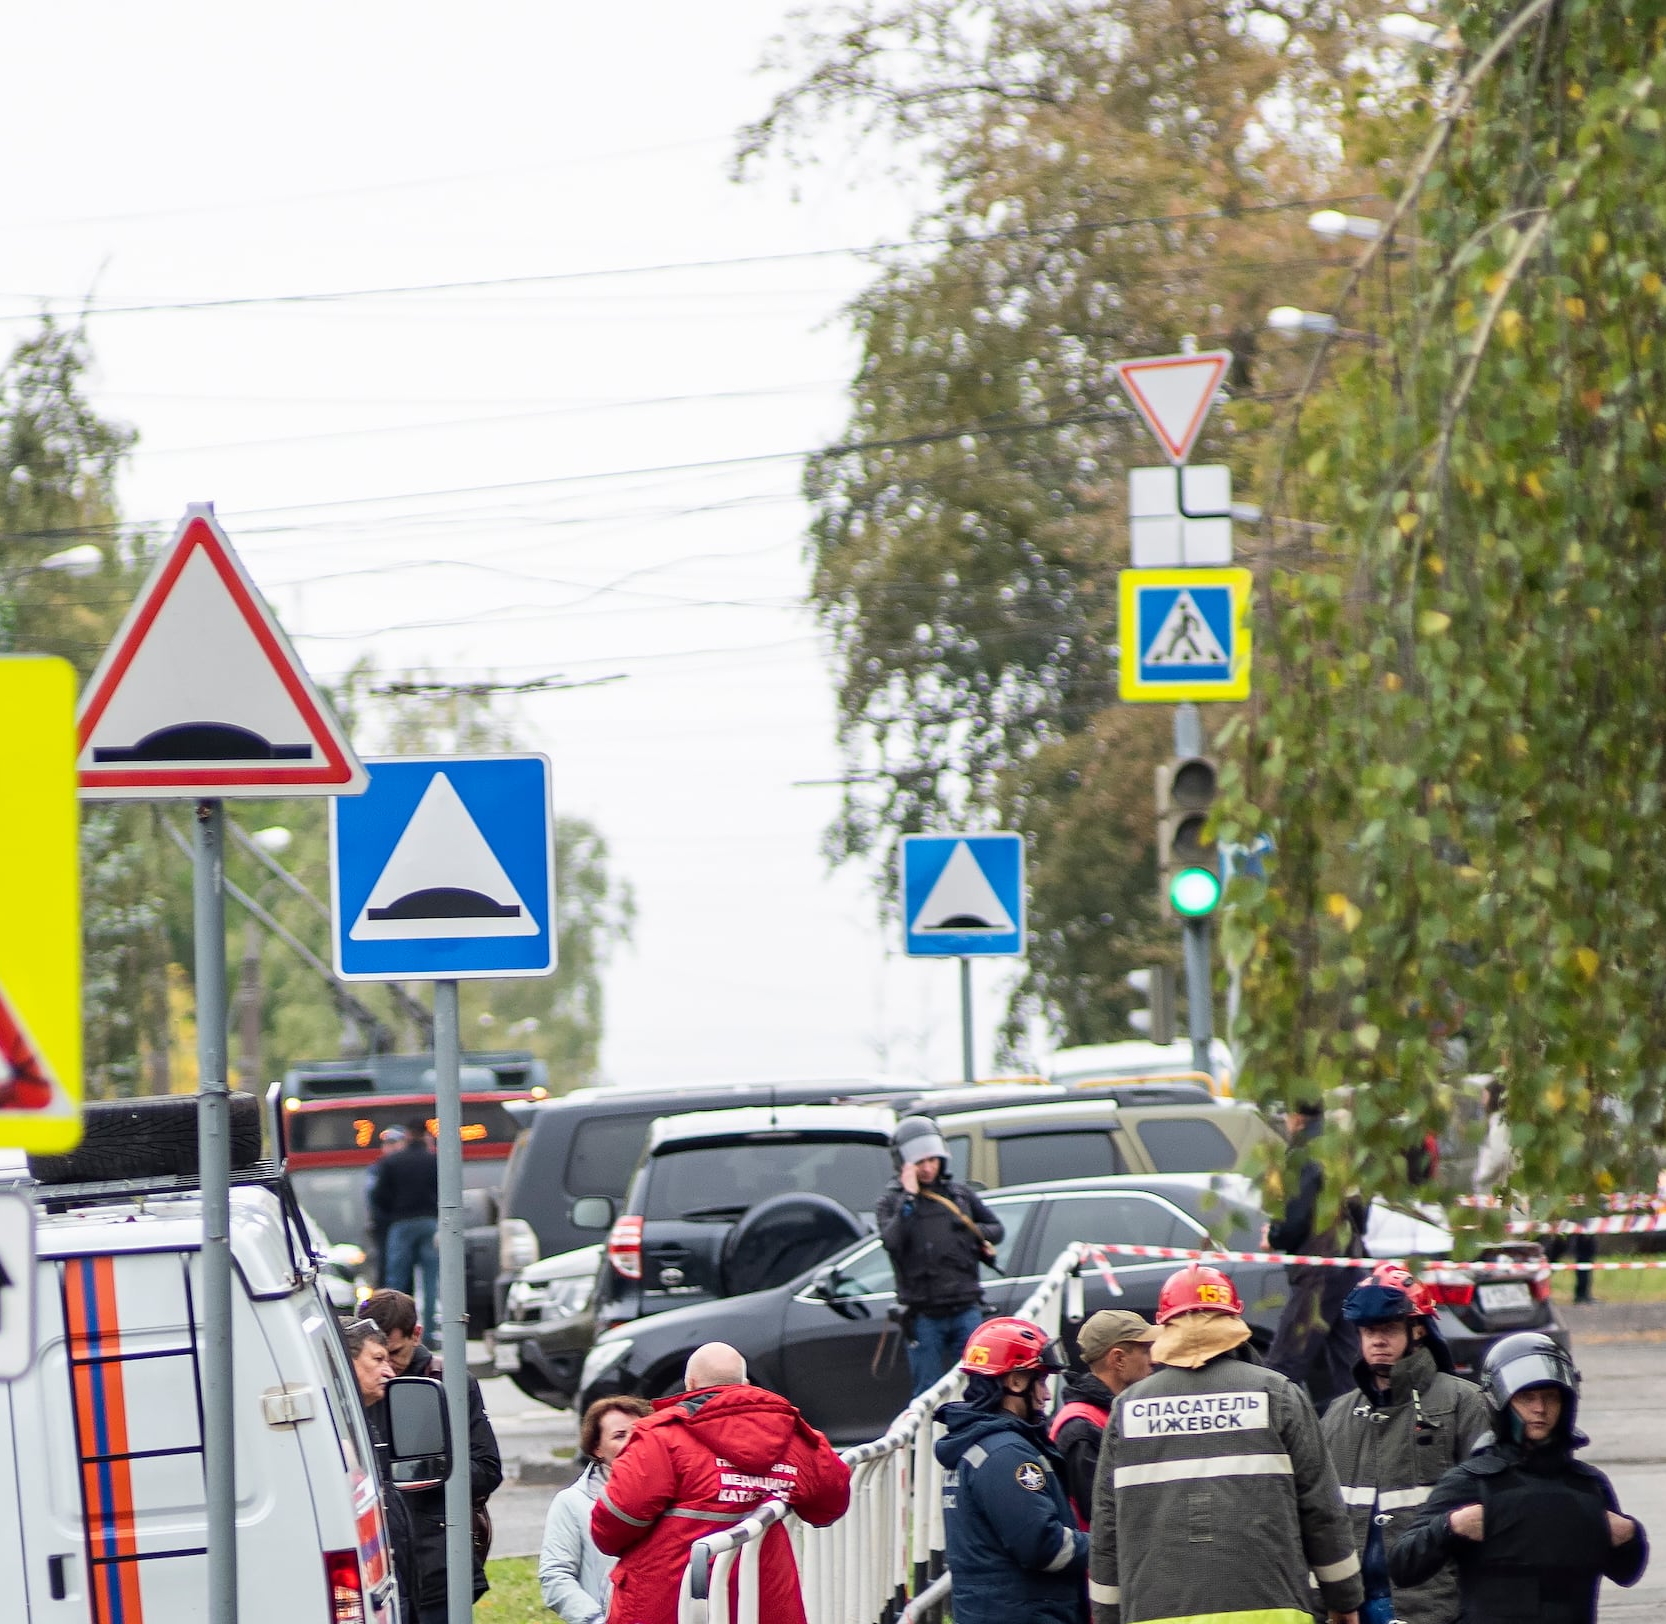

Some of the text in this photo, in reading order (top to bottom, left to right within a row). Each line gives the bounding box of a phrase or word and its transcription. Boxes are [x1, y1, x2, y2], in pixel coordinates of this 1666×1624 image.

[1196, 1284, 1232, 1304] 155
[1132, 1396, 1259, 1418] СПАСАТЕЛЬ
[1148, 1413, 1243, 1434] ИЖЕВСК
